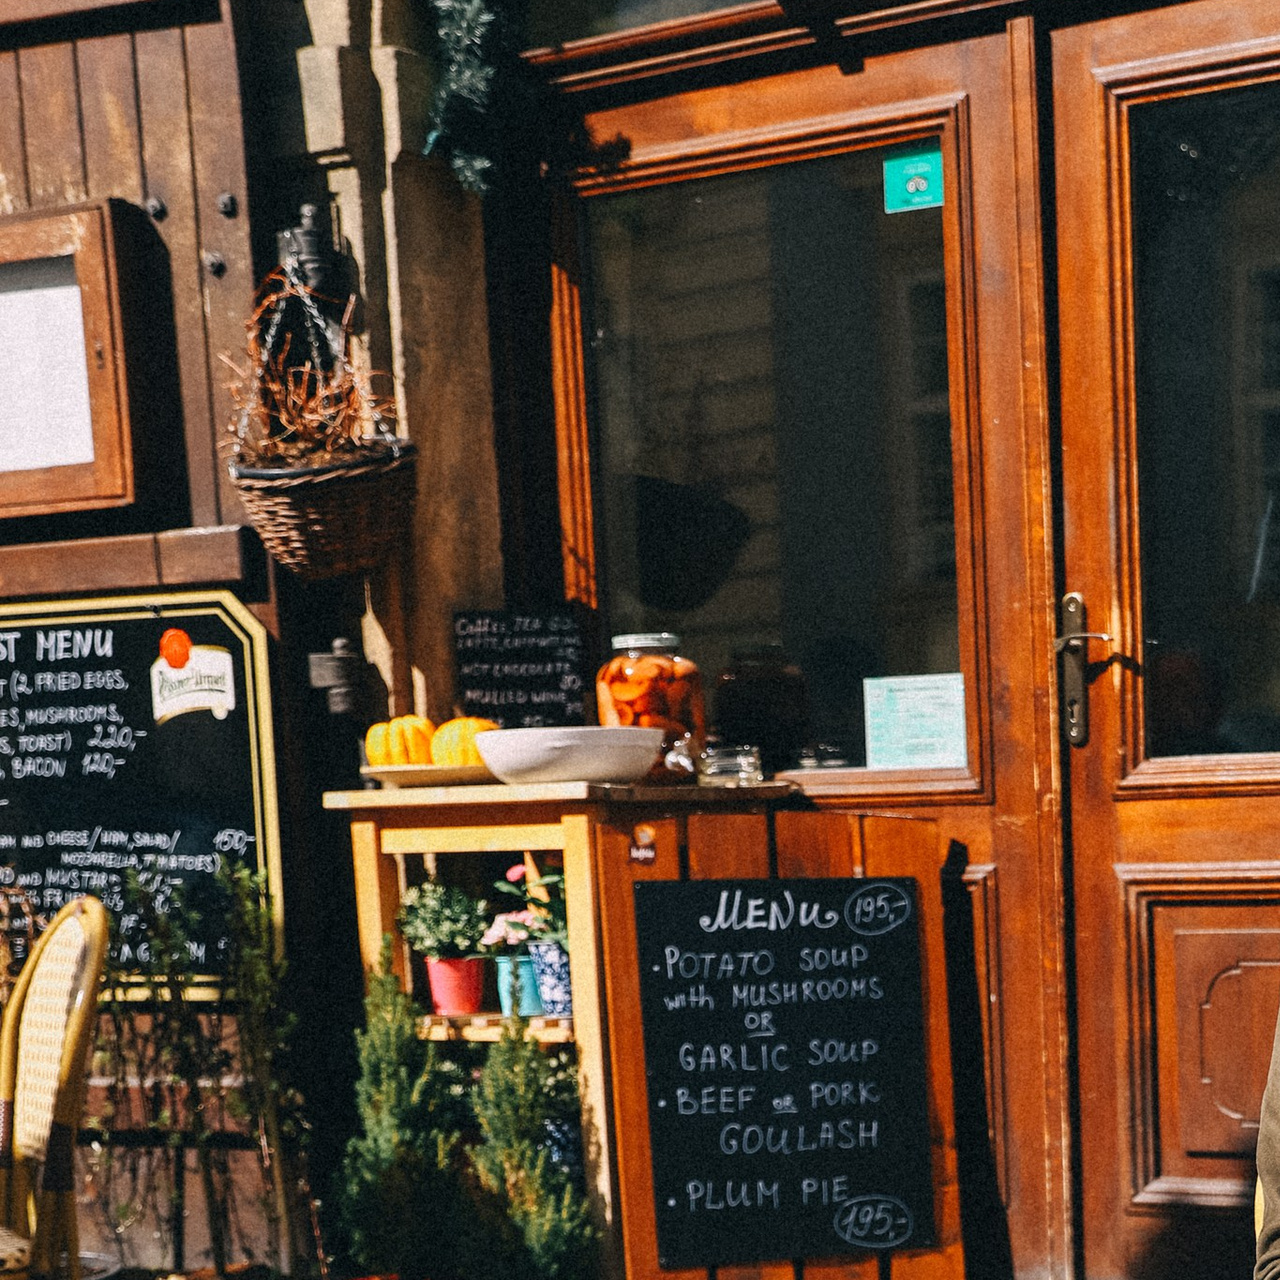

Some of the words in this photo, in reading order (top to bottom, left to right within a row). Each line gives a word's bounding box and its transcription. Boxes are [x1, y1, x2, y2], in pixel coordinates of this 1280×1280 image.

[36, 629, 114, 662] MENU
[34, 671, 81, 693] FRIED
[11, 756, 66, 779] BACON
[664, 945, 775, 980] POTATO
[799, 943, 868, 972] SOUP
[663, 984, 714, 1010] with
[732, 976, 885, 1008] MUSHROOMS
[744, 1010, 775, 1032] OR
[678, 1041, 789, 1072] GARLIC
[808, 1038, 879, 1065] SOUP
[676, 1085, 757, 1115] BEEF
[809, 1080, 880, 1109] PORK
[719, 1119, 878, 1155] GOULASH
[686, 1178, 780, 1212] PLUM
[801, 1175, 848, 1205] PIE
